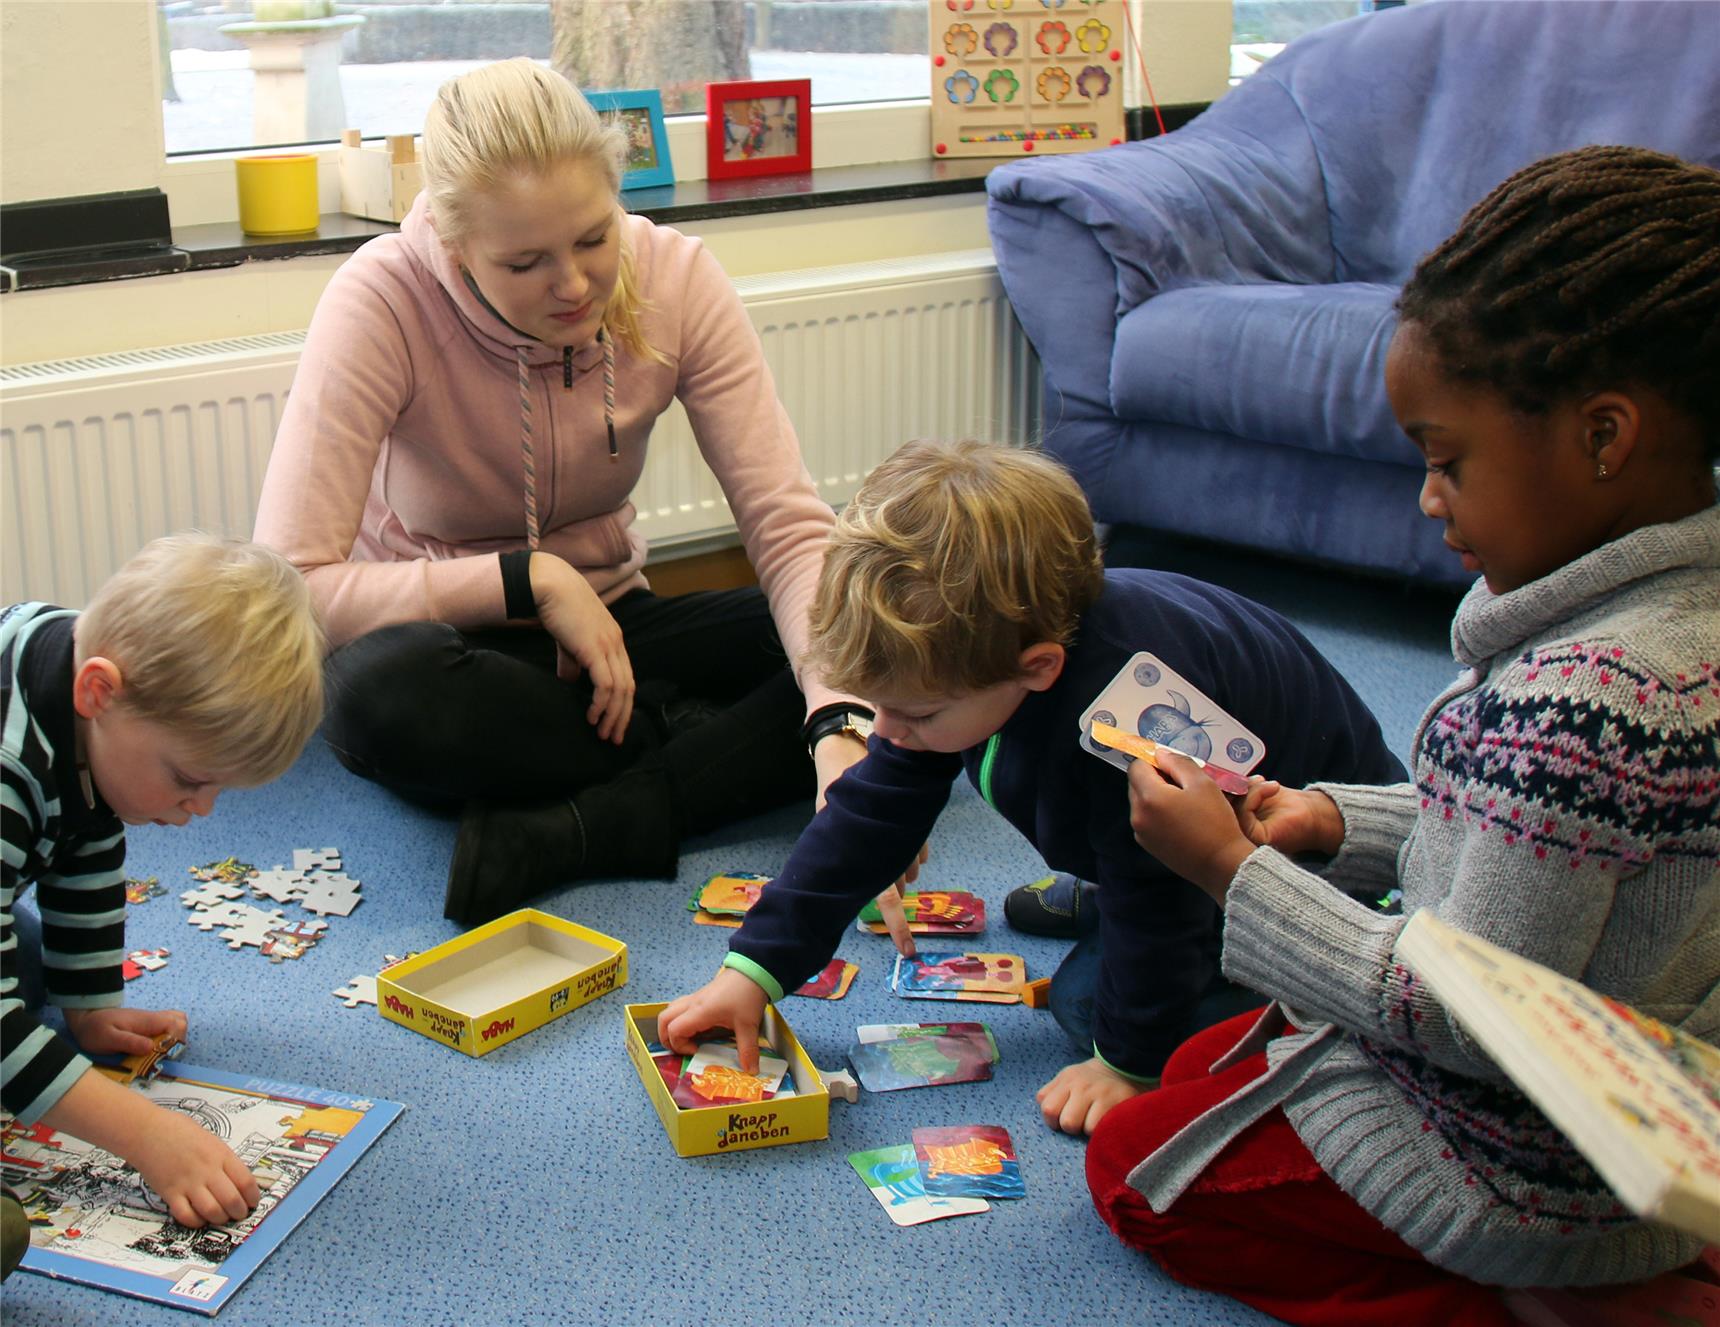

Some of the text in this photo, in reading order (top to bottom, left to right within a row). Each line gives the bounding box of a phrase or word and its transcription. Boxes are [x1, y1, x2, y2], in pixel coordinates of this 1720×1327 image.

[577, 955, 623, 989] daneben
[584, 973, 616, 998] Knapp
[384, 995, 414, 1020] HABA
[422, 1007, 465, 1033] daneben
[430, 1021, 460, 1046] Knapp
[481, 1017, 515, 1042] HABA
[244, 1079, 350, 1107] PUZZLE 40
[728, 1113, 777, 1132] Knapp
[717, 1126, 789, 1149] daneben
